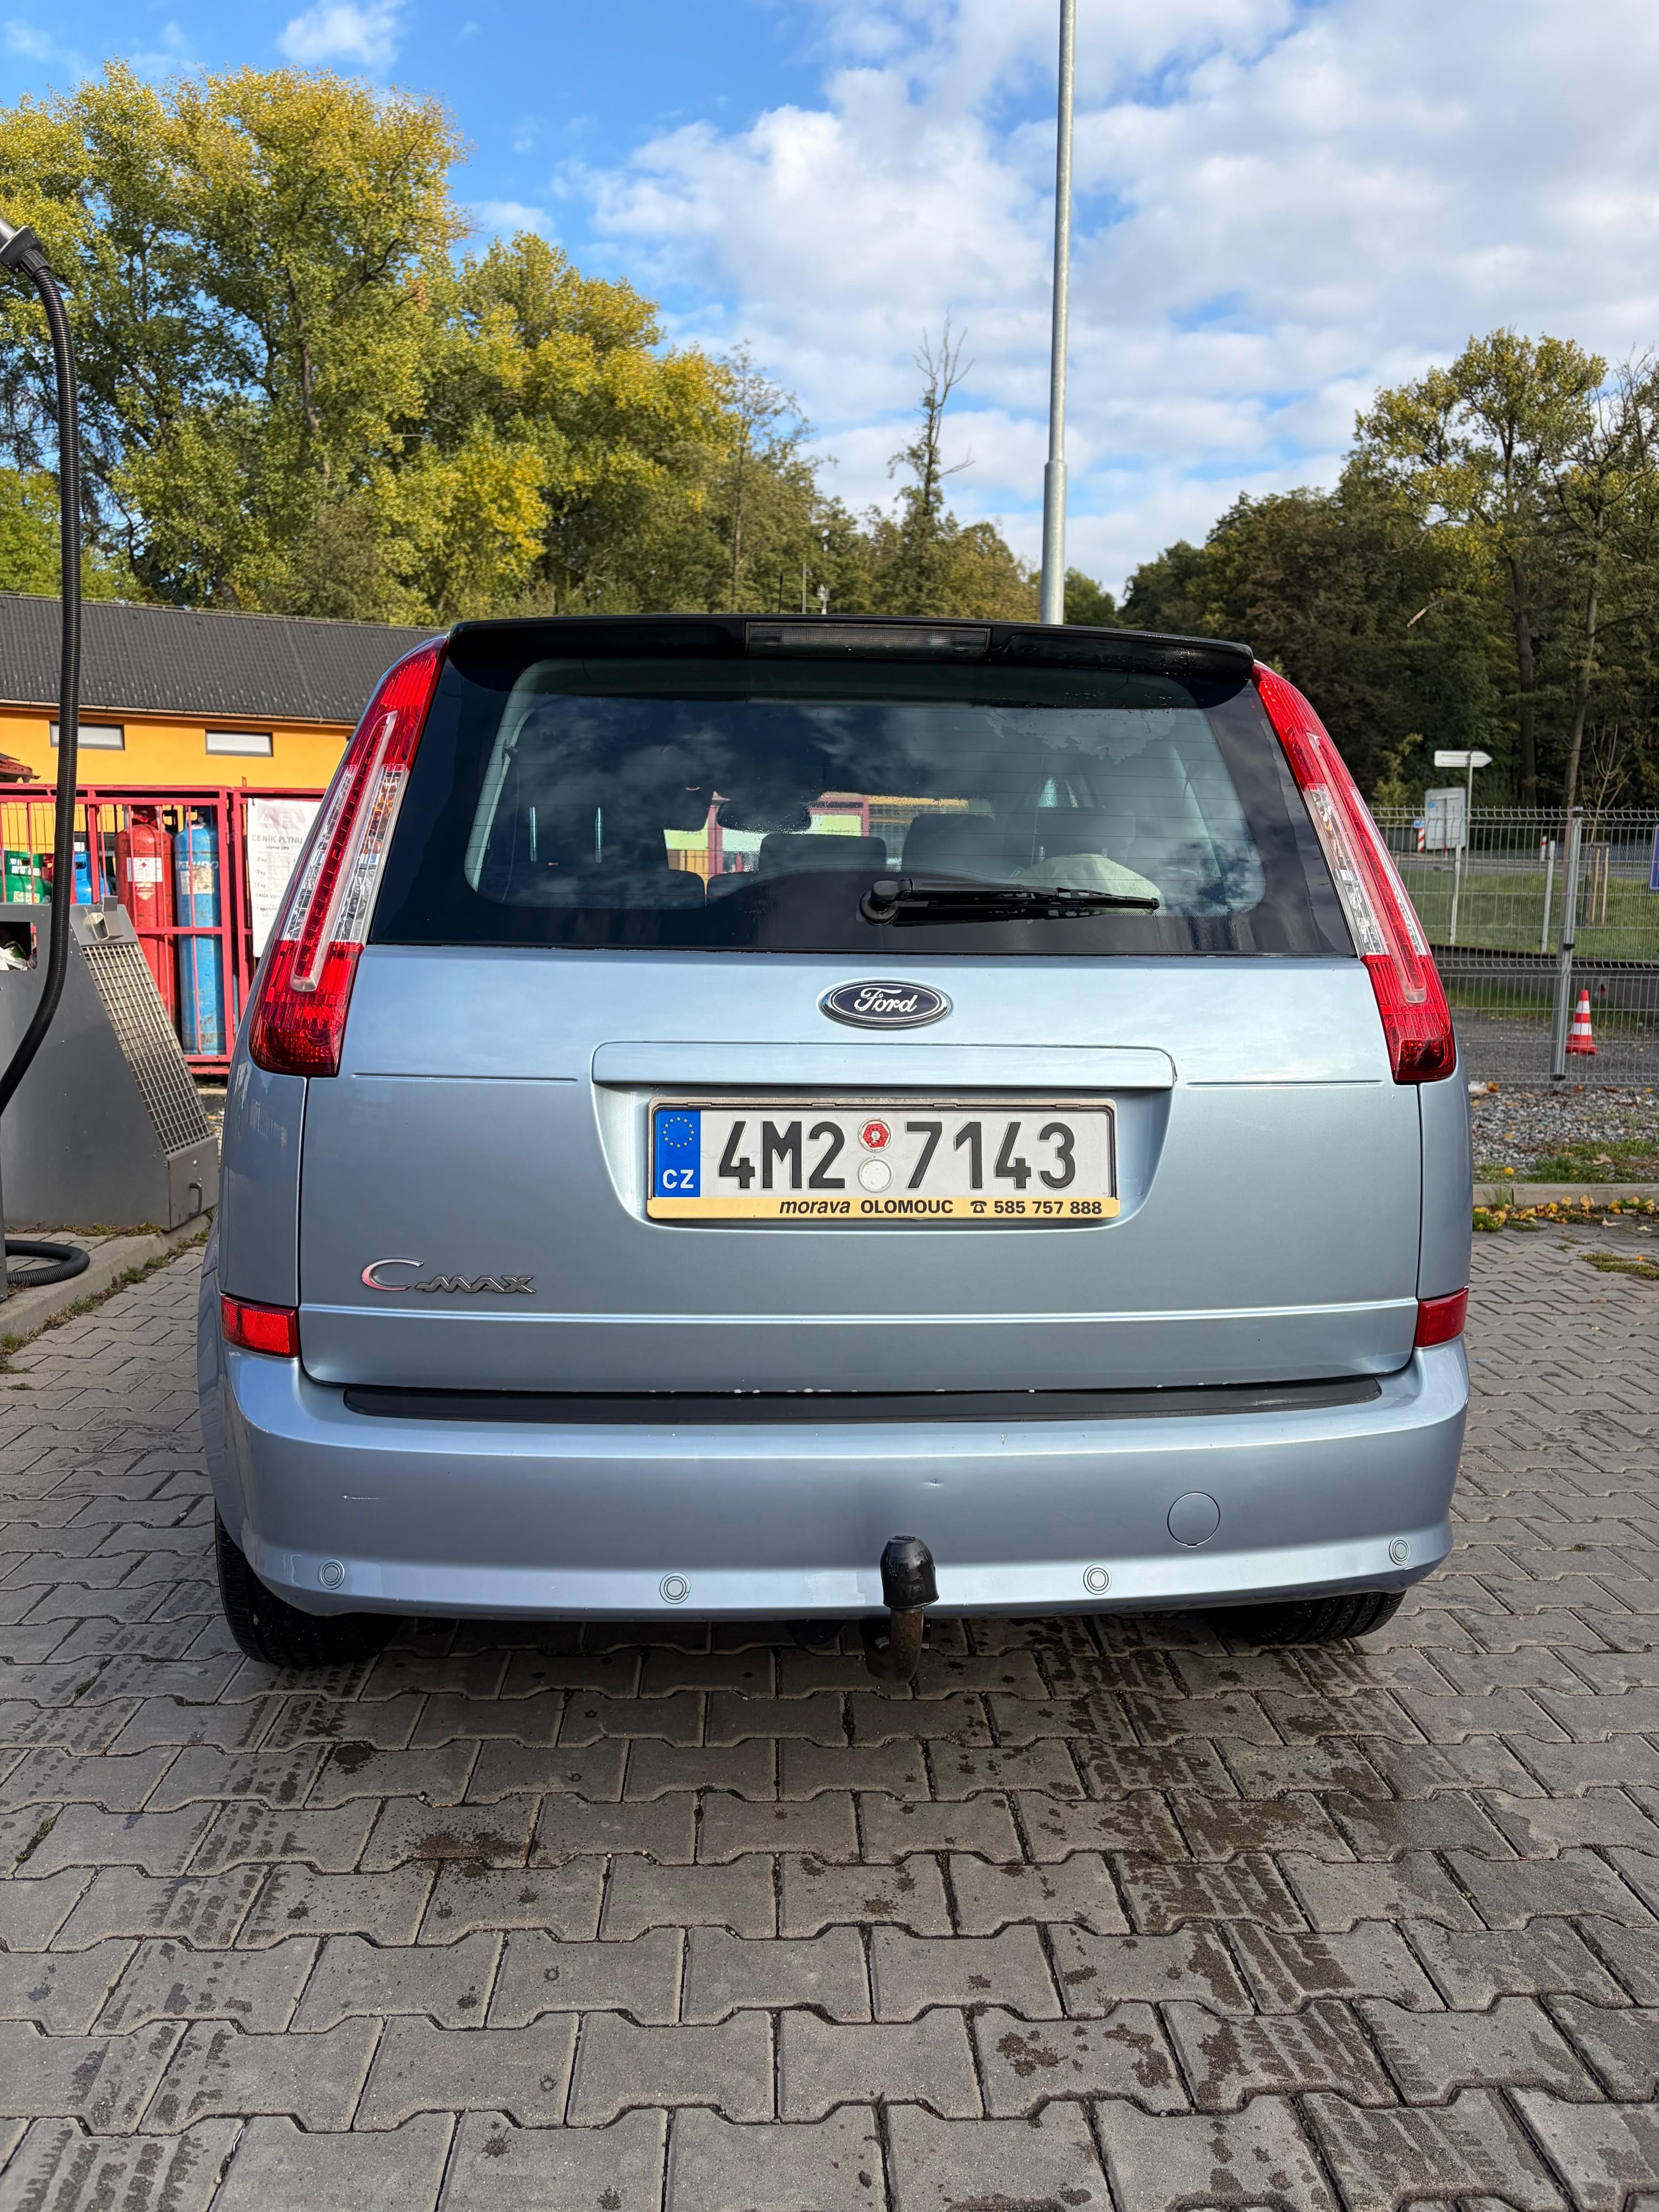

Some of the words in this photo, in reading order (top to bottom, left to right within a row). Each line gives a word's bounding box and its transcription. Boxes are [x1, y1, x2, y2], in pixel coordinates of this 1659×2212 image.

[252, 834, 276, 844] CENÍK
[278, 835, 303, 844] PLYNU
[854, 987, 919, 1013] Ford
[719, 1121, 846, 1189] 4M2
[906, 1121, 1076, 1189] 7143
[663, 1169, 694, 1189] CZ
[779, 1201, 851, 1214] morava
[861, 1199, 954, 1214] OLOMOUC
[994, 1201, 1026, 1214] 585
[1032, 1201, 1063, 1214] 757
[1070, 1201, 1102, 1214] 888
